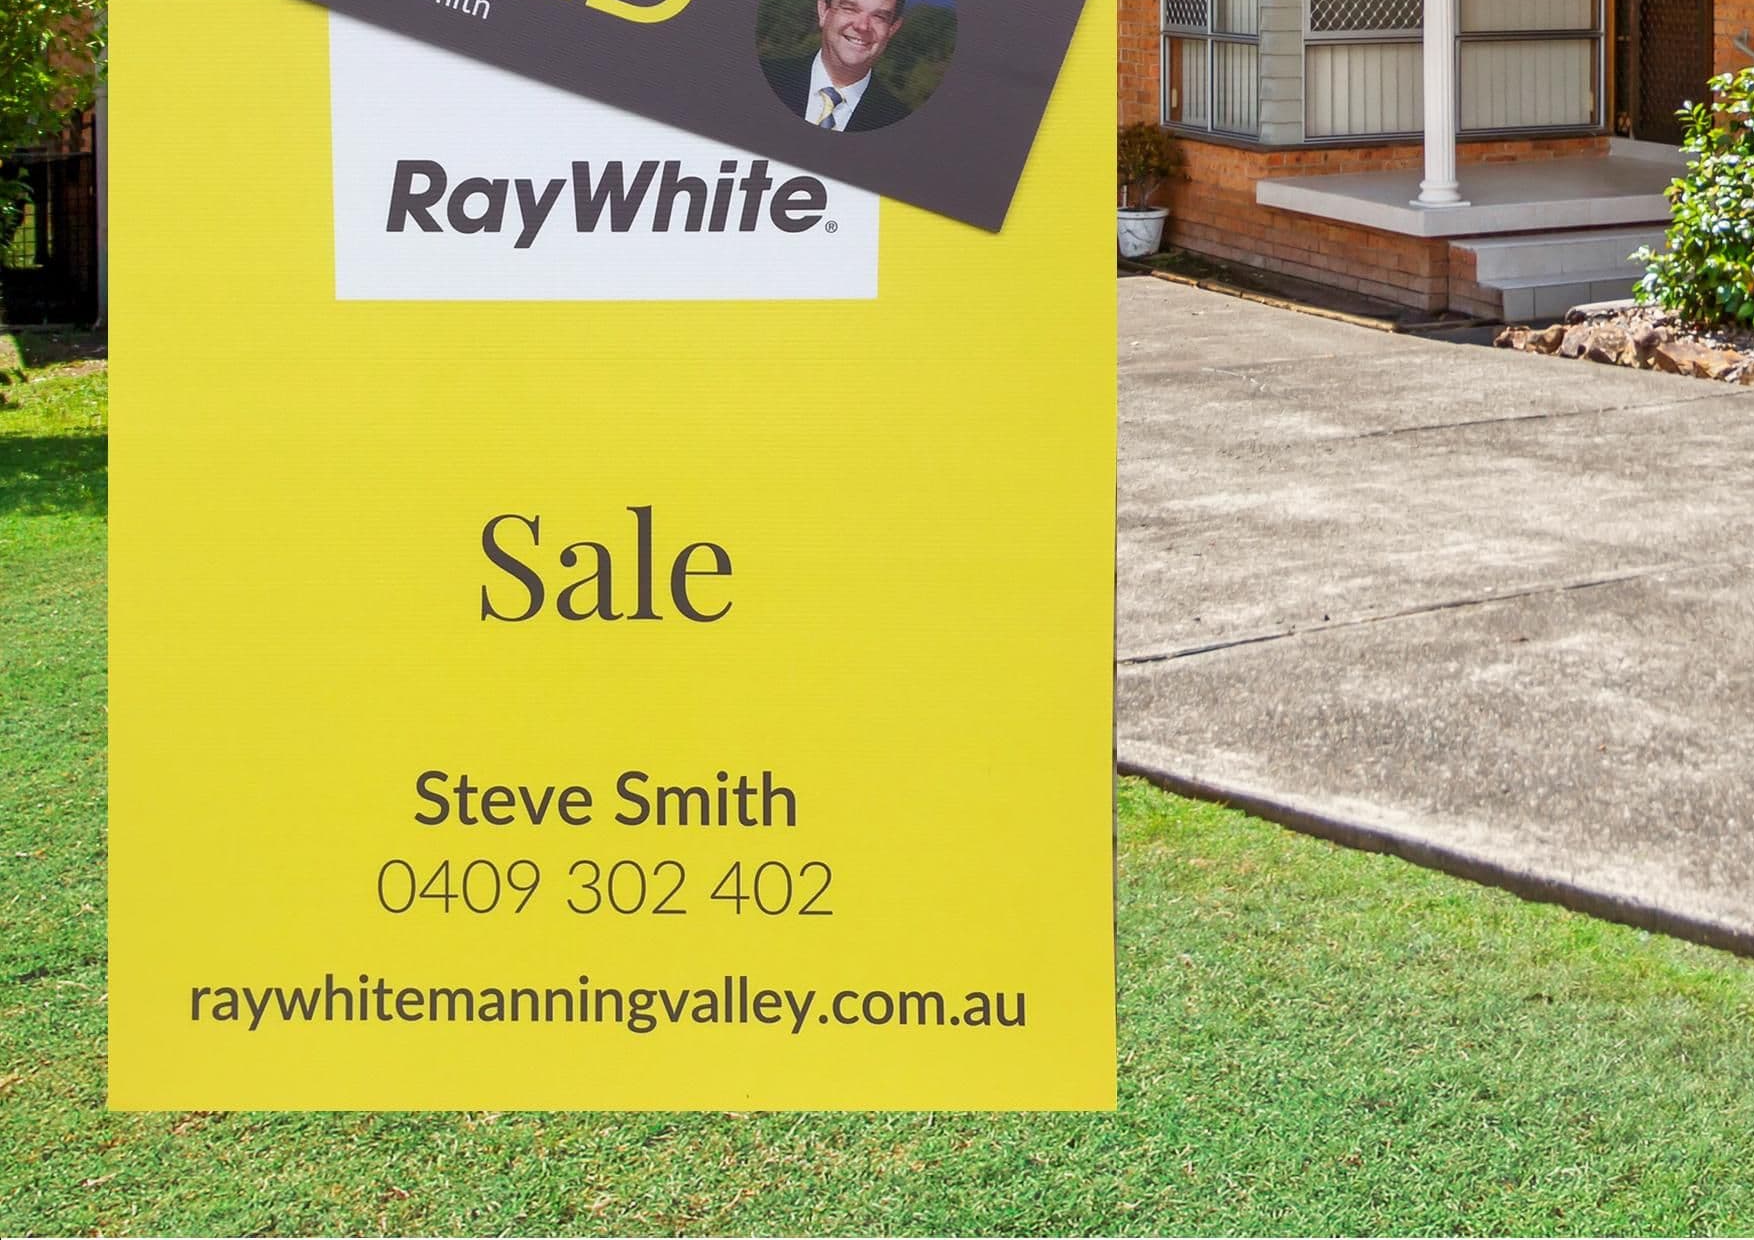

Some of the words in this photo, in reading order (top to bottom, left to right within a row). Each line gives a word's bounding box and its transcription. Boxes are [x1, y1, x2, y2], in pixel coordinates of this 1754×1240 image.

[480, 504, 734, 623] Sale
[415, 771, 592, 825] Steve
[615, 771, 795, 826] Smith
[378, 860, 539, 913] 0409
[568, 860, 686, 914] 302
[711, 862, 832, 915] 402
[192, 974, 1025, 1034] raywhitemanningvalley.com.au
